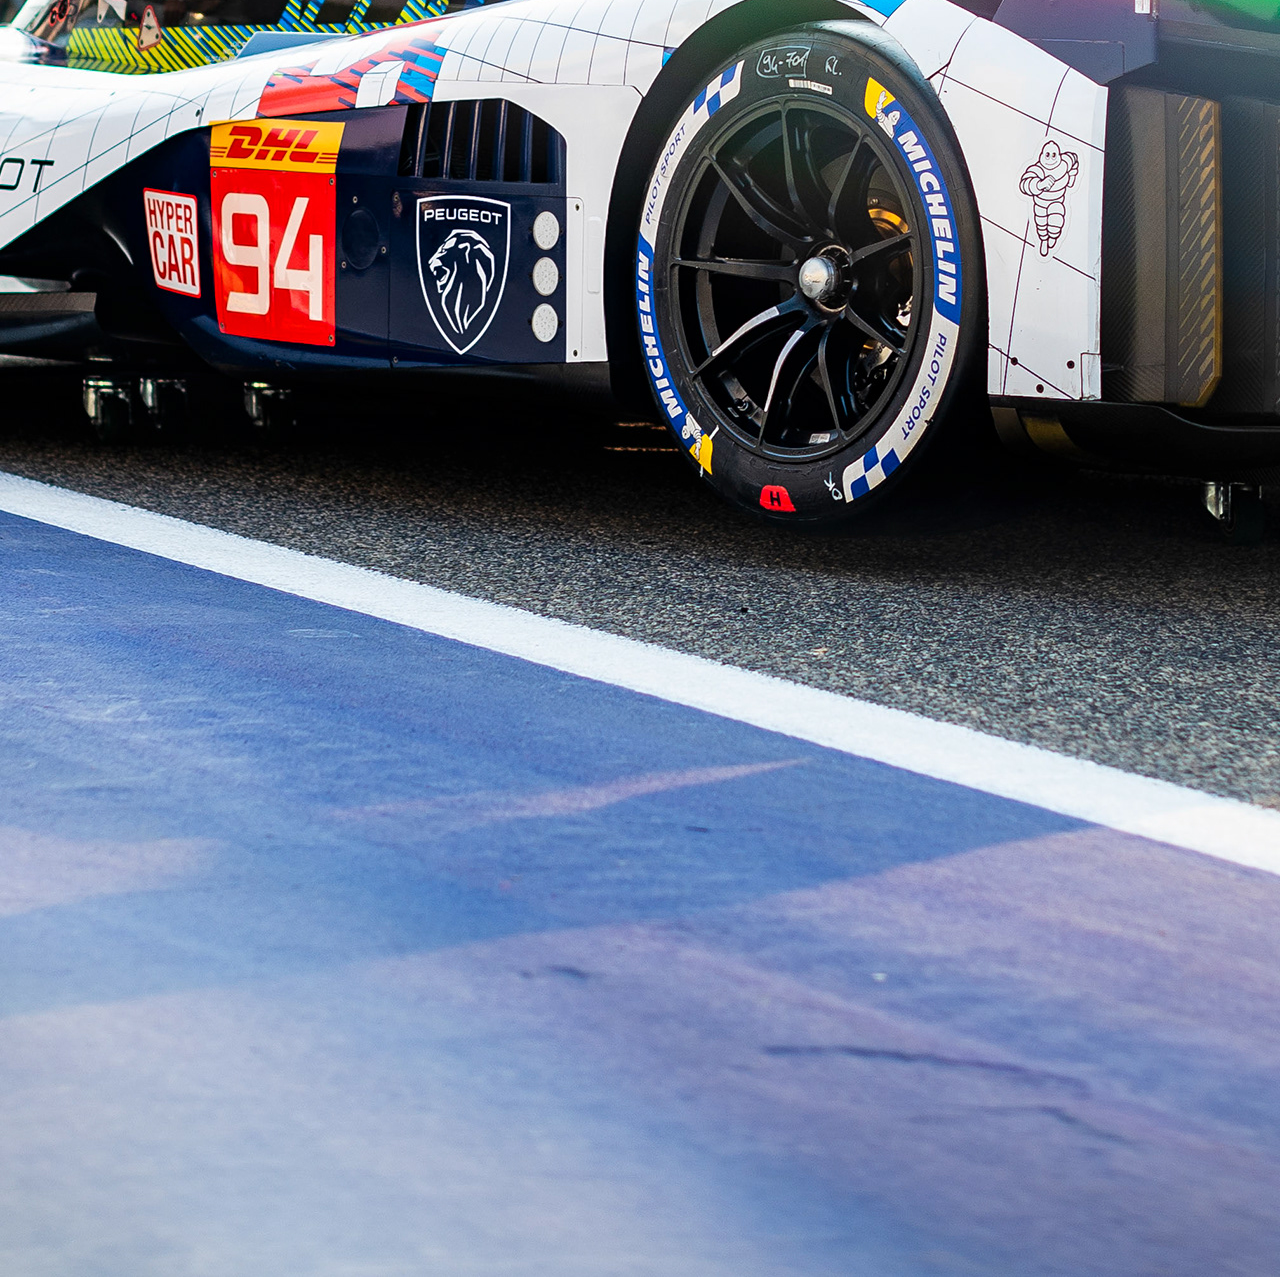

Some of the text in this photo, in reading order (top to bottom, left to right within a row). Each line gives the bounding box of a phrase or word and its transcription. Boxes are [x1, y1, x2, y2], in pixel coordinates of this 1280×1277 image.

[226, 125, 319, 164] DHL
[644, 124, 687, 226] PILOT SPORT
[147, 197, 194, 236] HYPER
[424, 209, 503, 226] PEUGEOT
[898, 130, 957, 305] MICHELIN
[152, 231, 197, 287] CAR
[221, 192, 324, 322] 94
[638, 252, 682, 420] MICHELIN
[901, 333, 948, 440] PILOT SPORT
[769, 490, 782, 507] H
